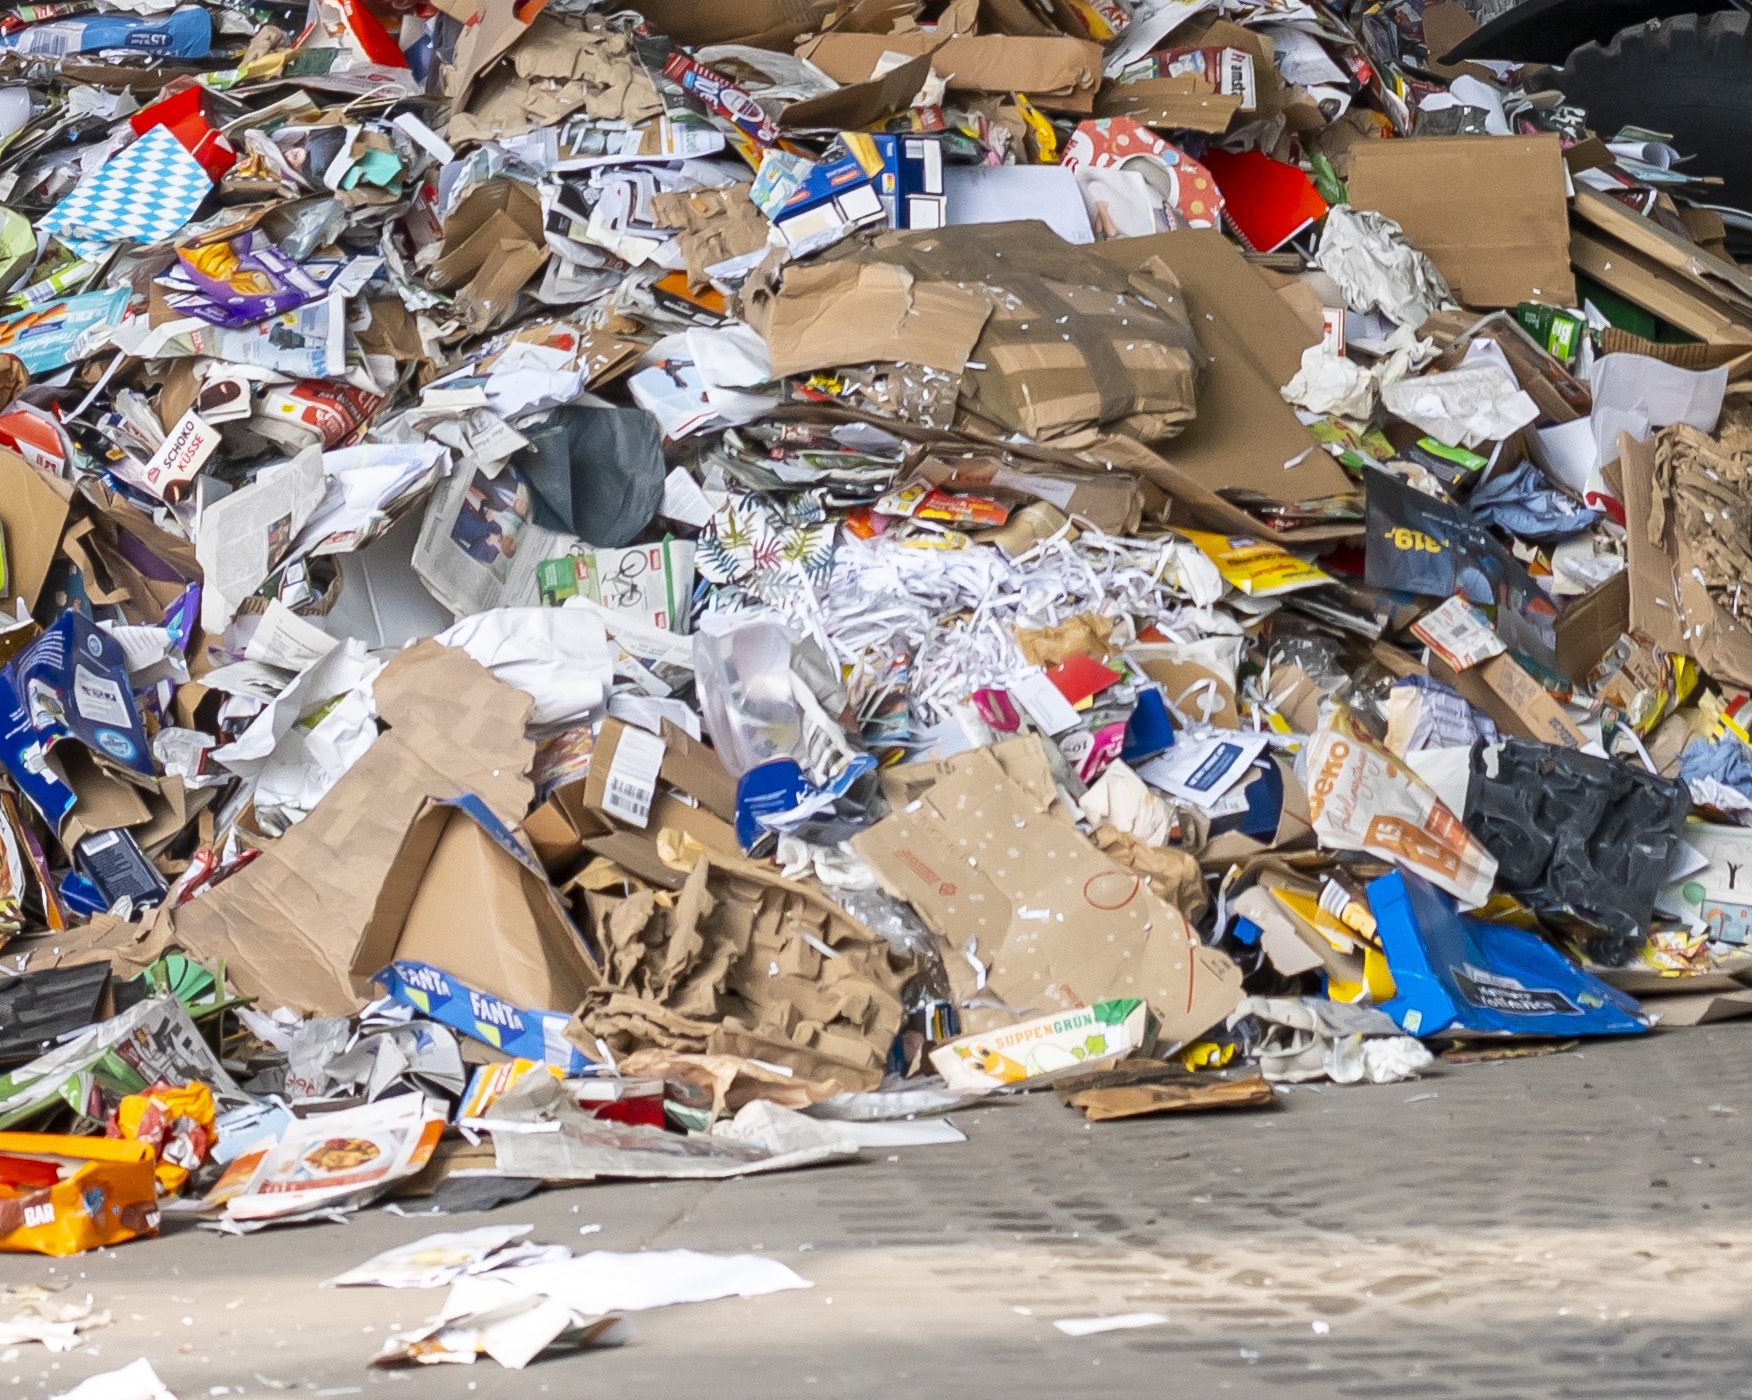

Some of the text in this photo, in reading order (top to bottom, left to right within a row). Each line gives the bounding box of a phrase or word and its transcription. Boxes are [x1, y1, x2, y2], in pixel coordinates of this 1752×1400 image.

[163, 420, 196, 470] SCHOKO
[176, 433, 205, 473] KÜSSE
[23, 1203, 56, 1229] BAR
